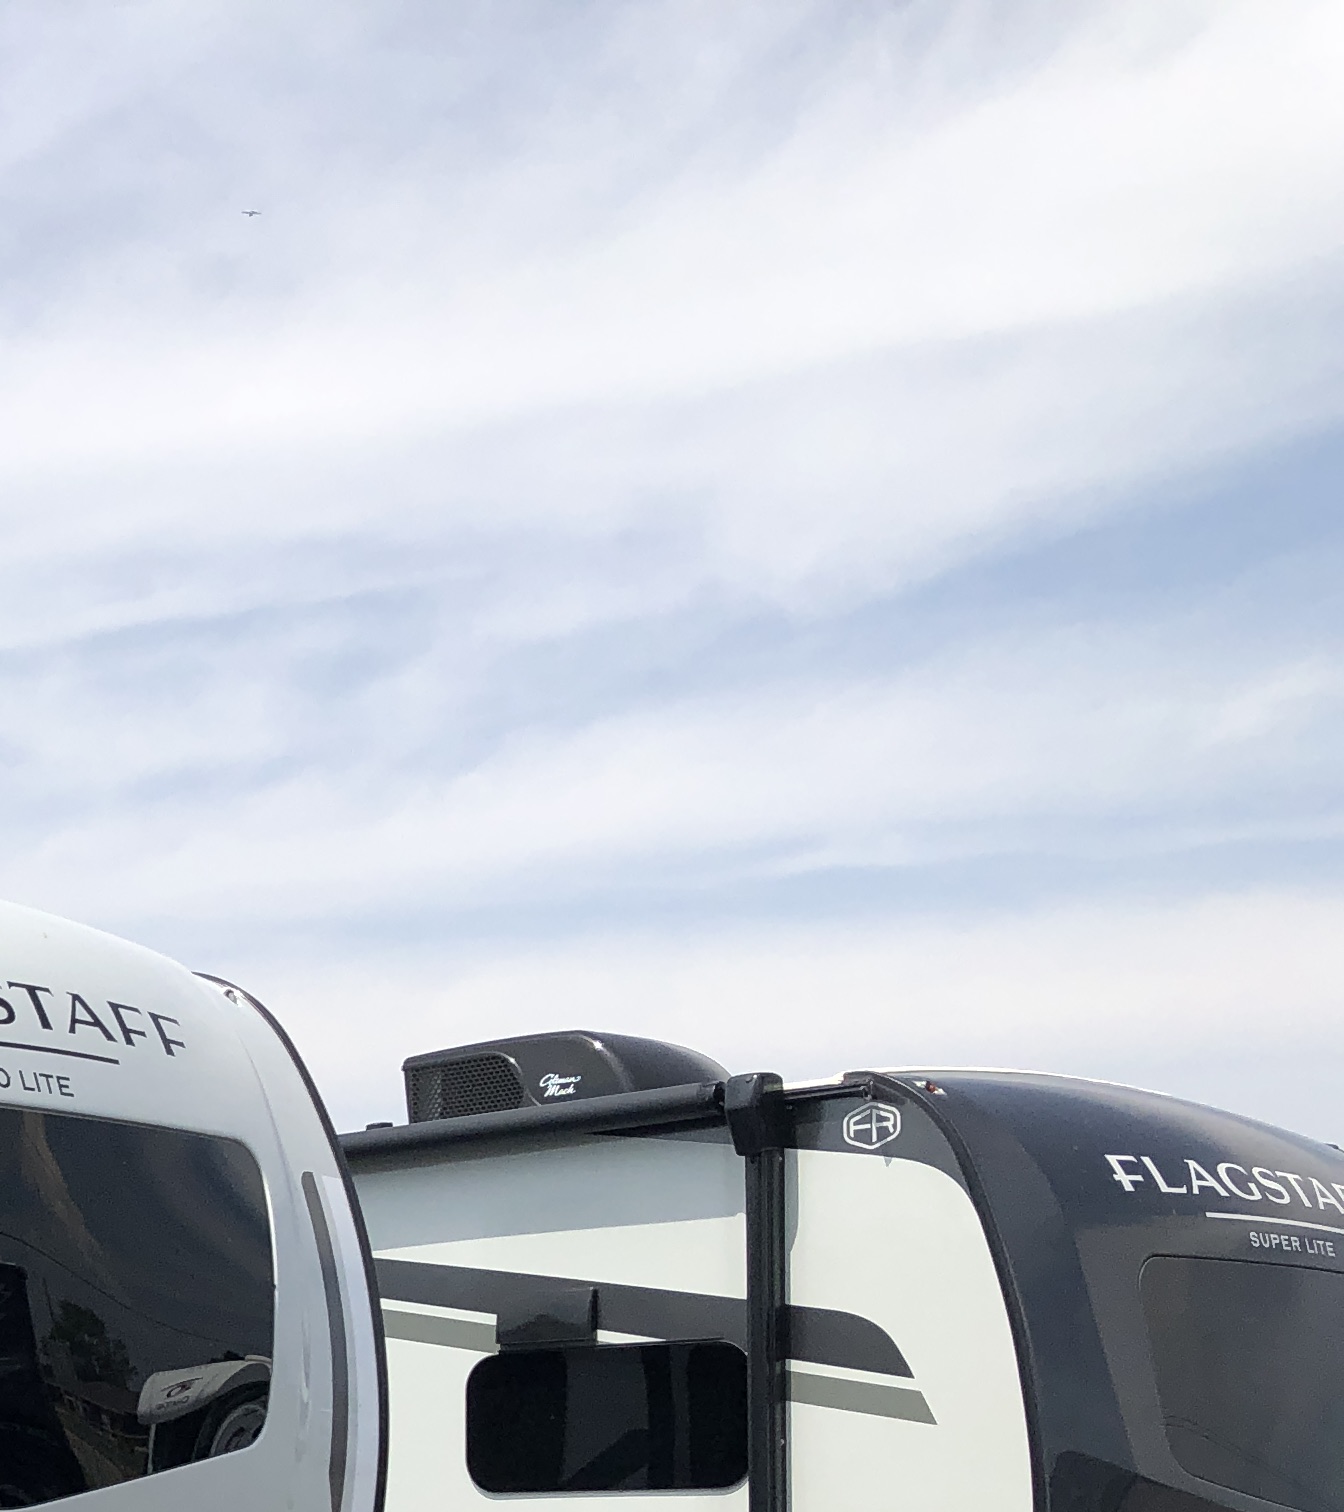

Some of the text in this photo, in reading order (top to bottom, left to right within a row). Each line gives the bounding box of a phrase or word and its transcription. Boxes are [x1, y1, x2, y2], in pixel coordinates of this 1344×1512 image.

[19, 1070, 75, 1099] LITE
[1250, 1232, 1336, 1257] SUPER LITE
